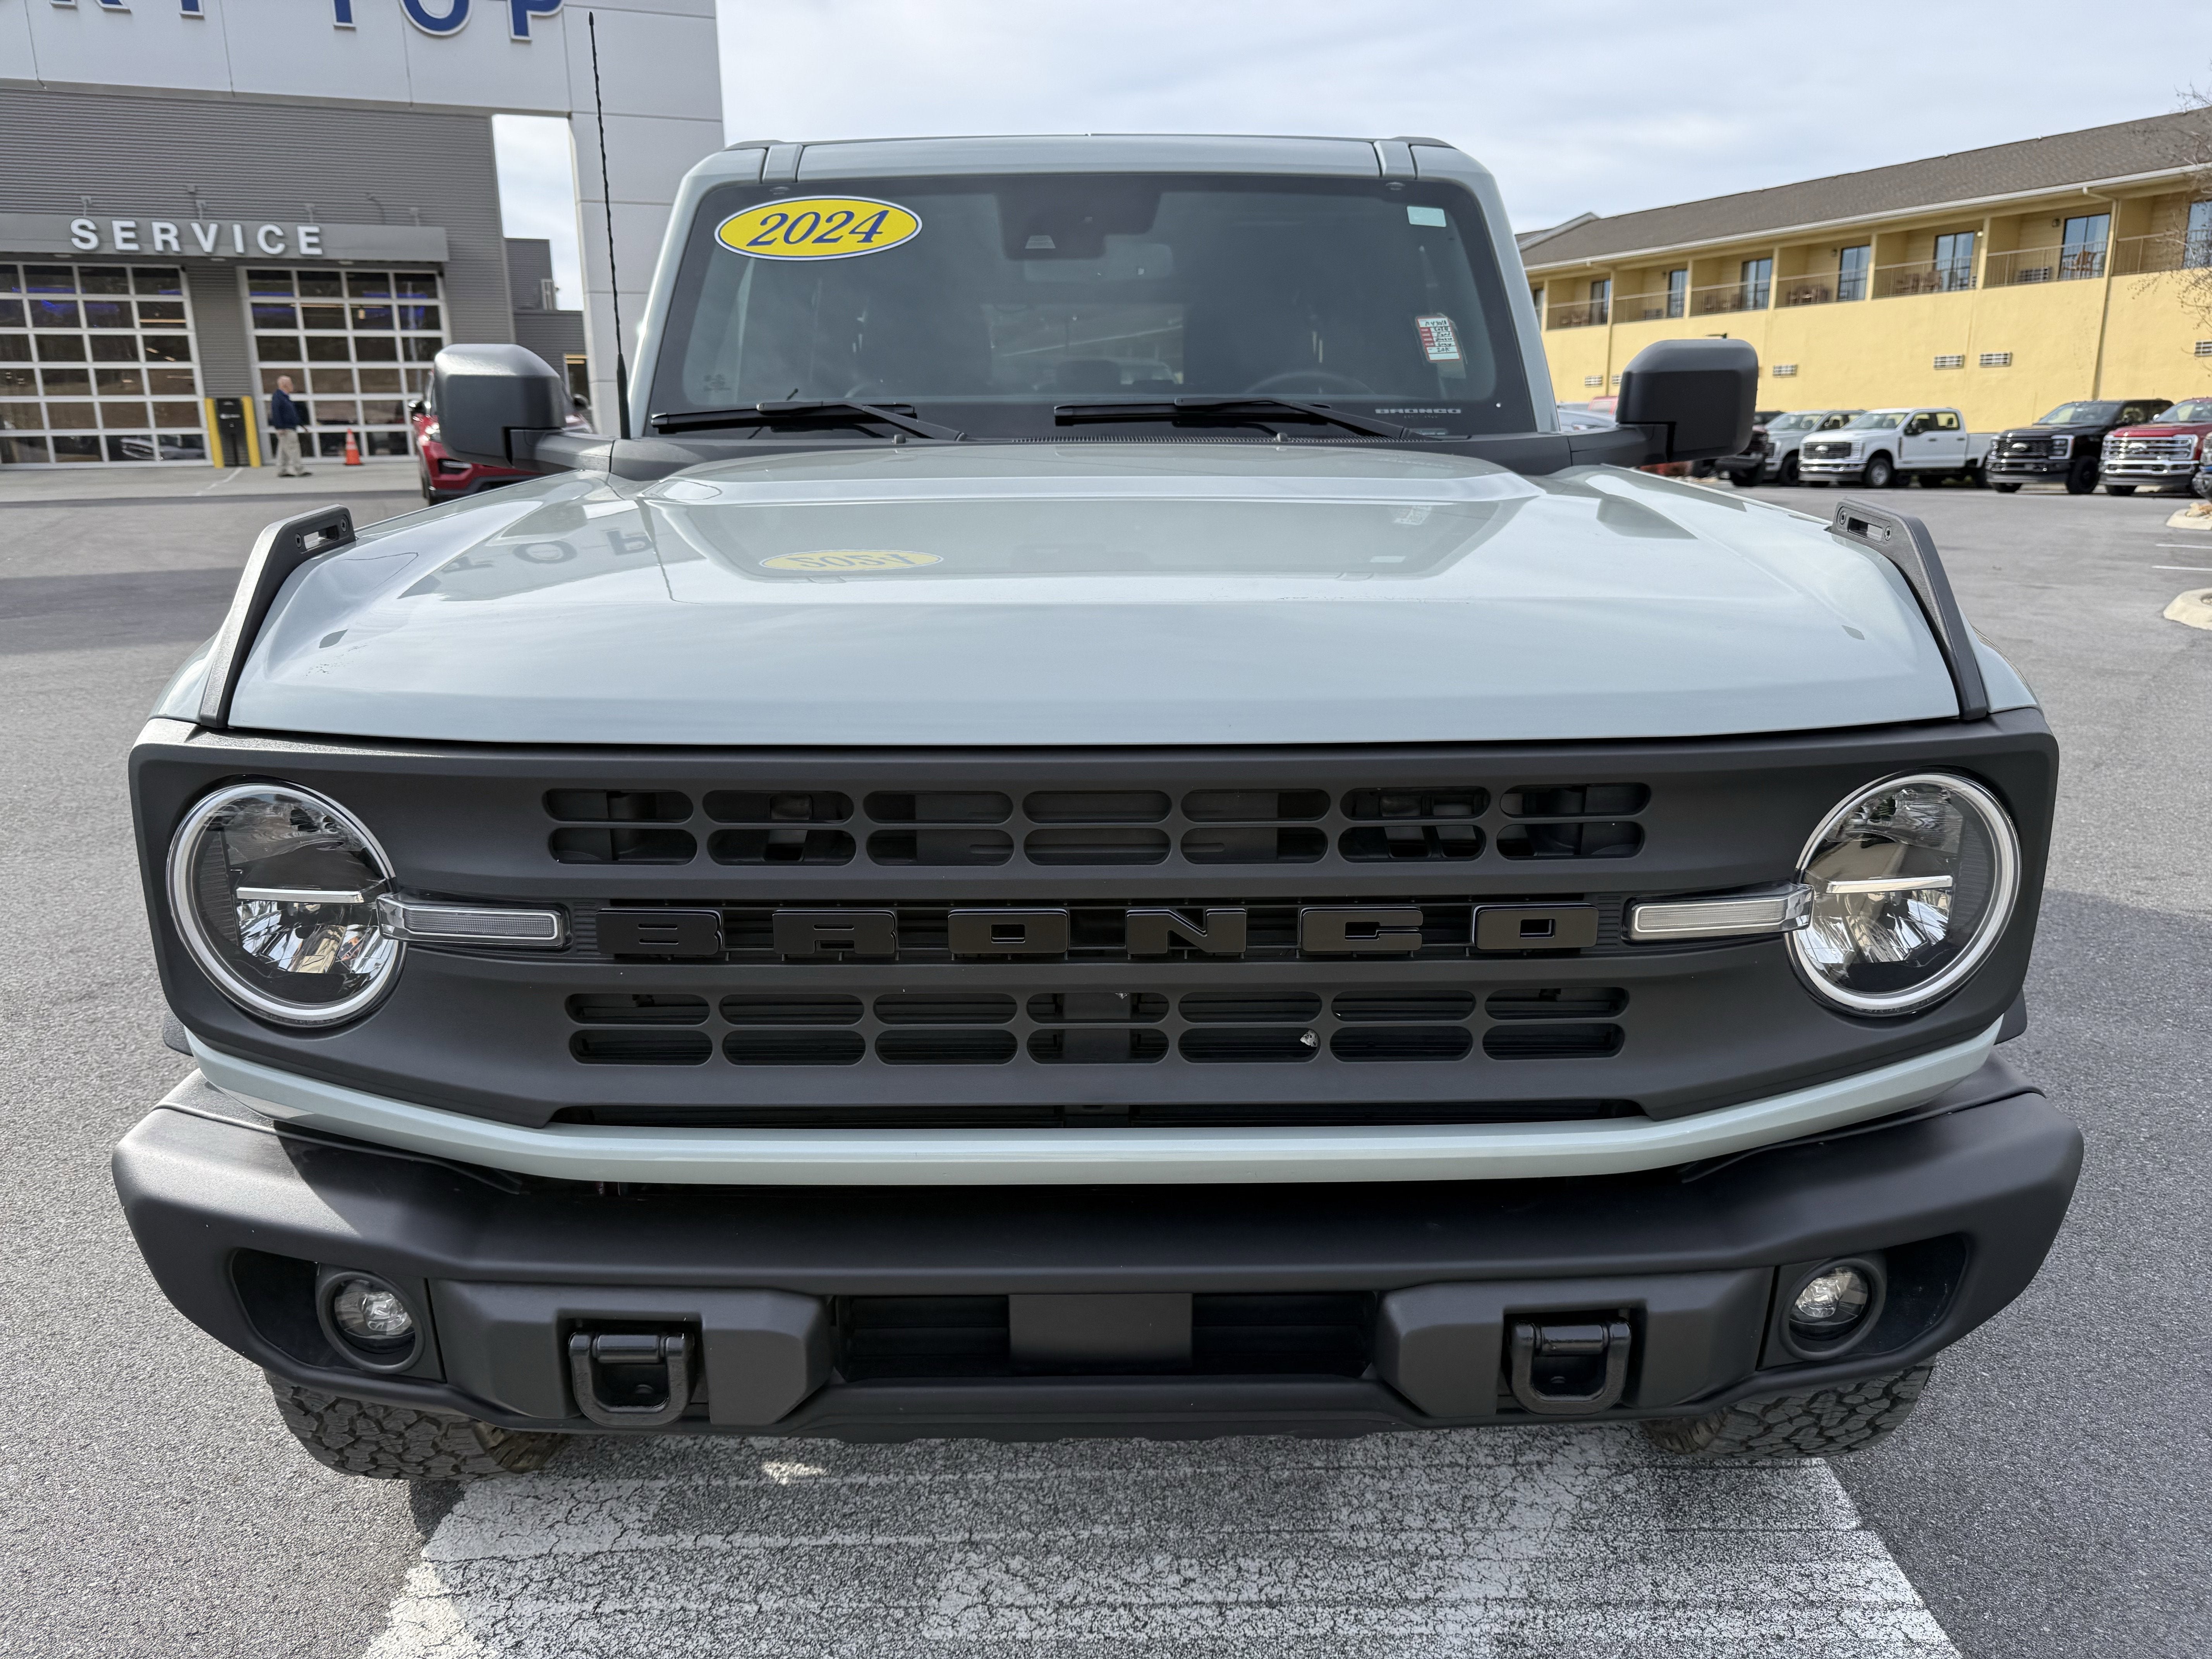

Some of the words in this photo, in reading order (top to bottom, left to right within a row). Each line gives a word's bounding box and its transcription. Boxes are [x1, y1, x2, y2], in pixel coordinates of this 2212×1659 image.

[70, 217, 323, 255] SERVICE
[746, 210, 890, 247] 2024
[596, 903, 1599, 955] BRONCO
